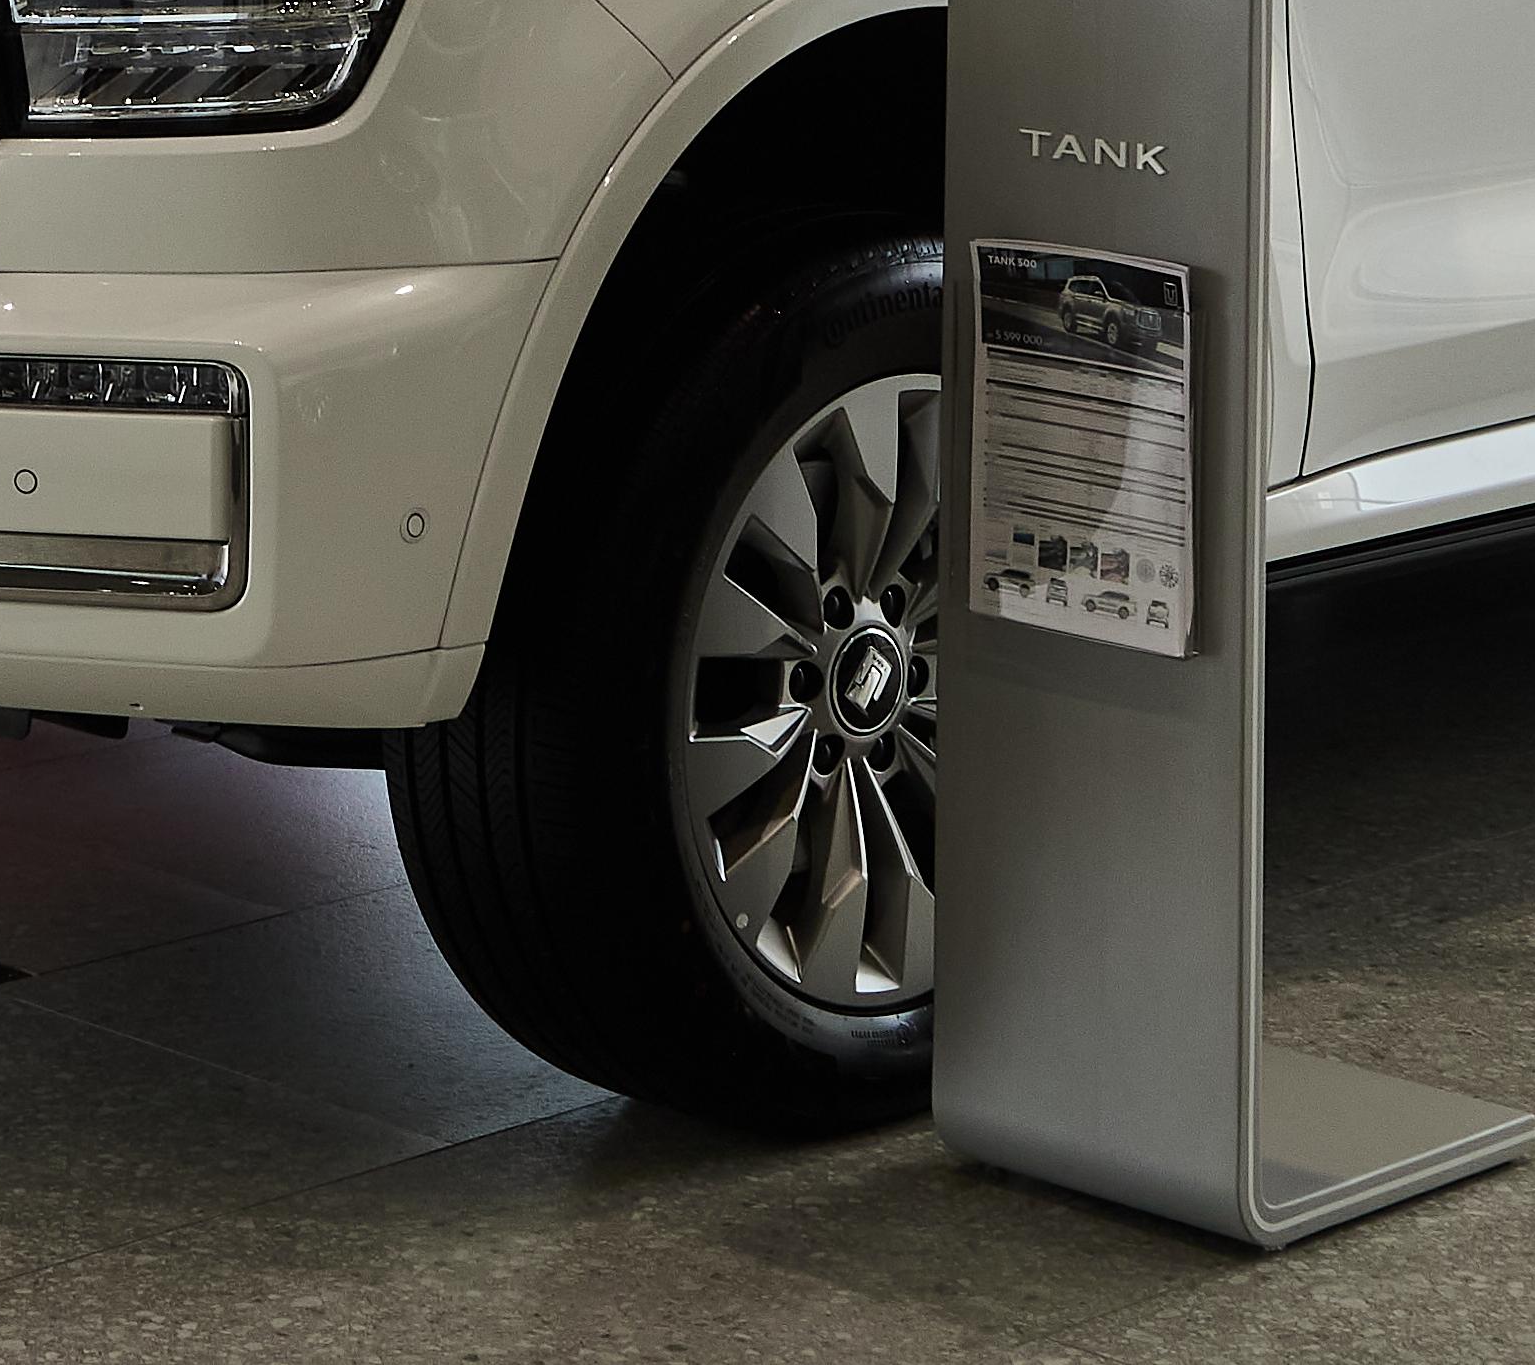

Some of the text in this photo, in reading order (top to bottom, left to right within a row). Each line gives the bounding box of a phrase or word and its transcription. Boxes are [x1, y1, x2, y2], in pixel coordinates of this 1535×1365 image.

[1018, 128, 1168, 176] TANK
[987, 254, 1038, 269] TANK 500
[817, 281, 943, 351] Continenta
[1022, 334, 1043, 346] 000
